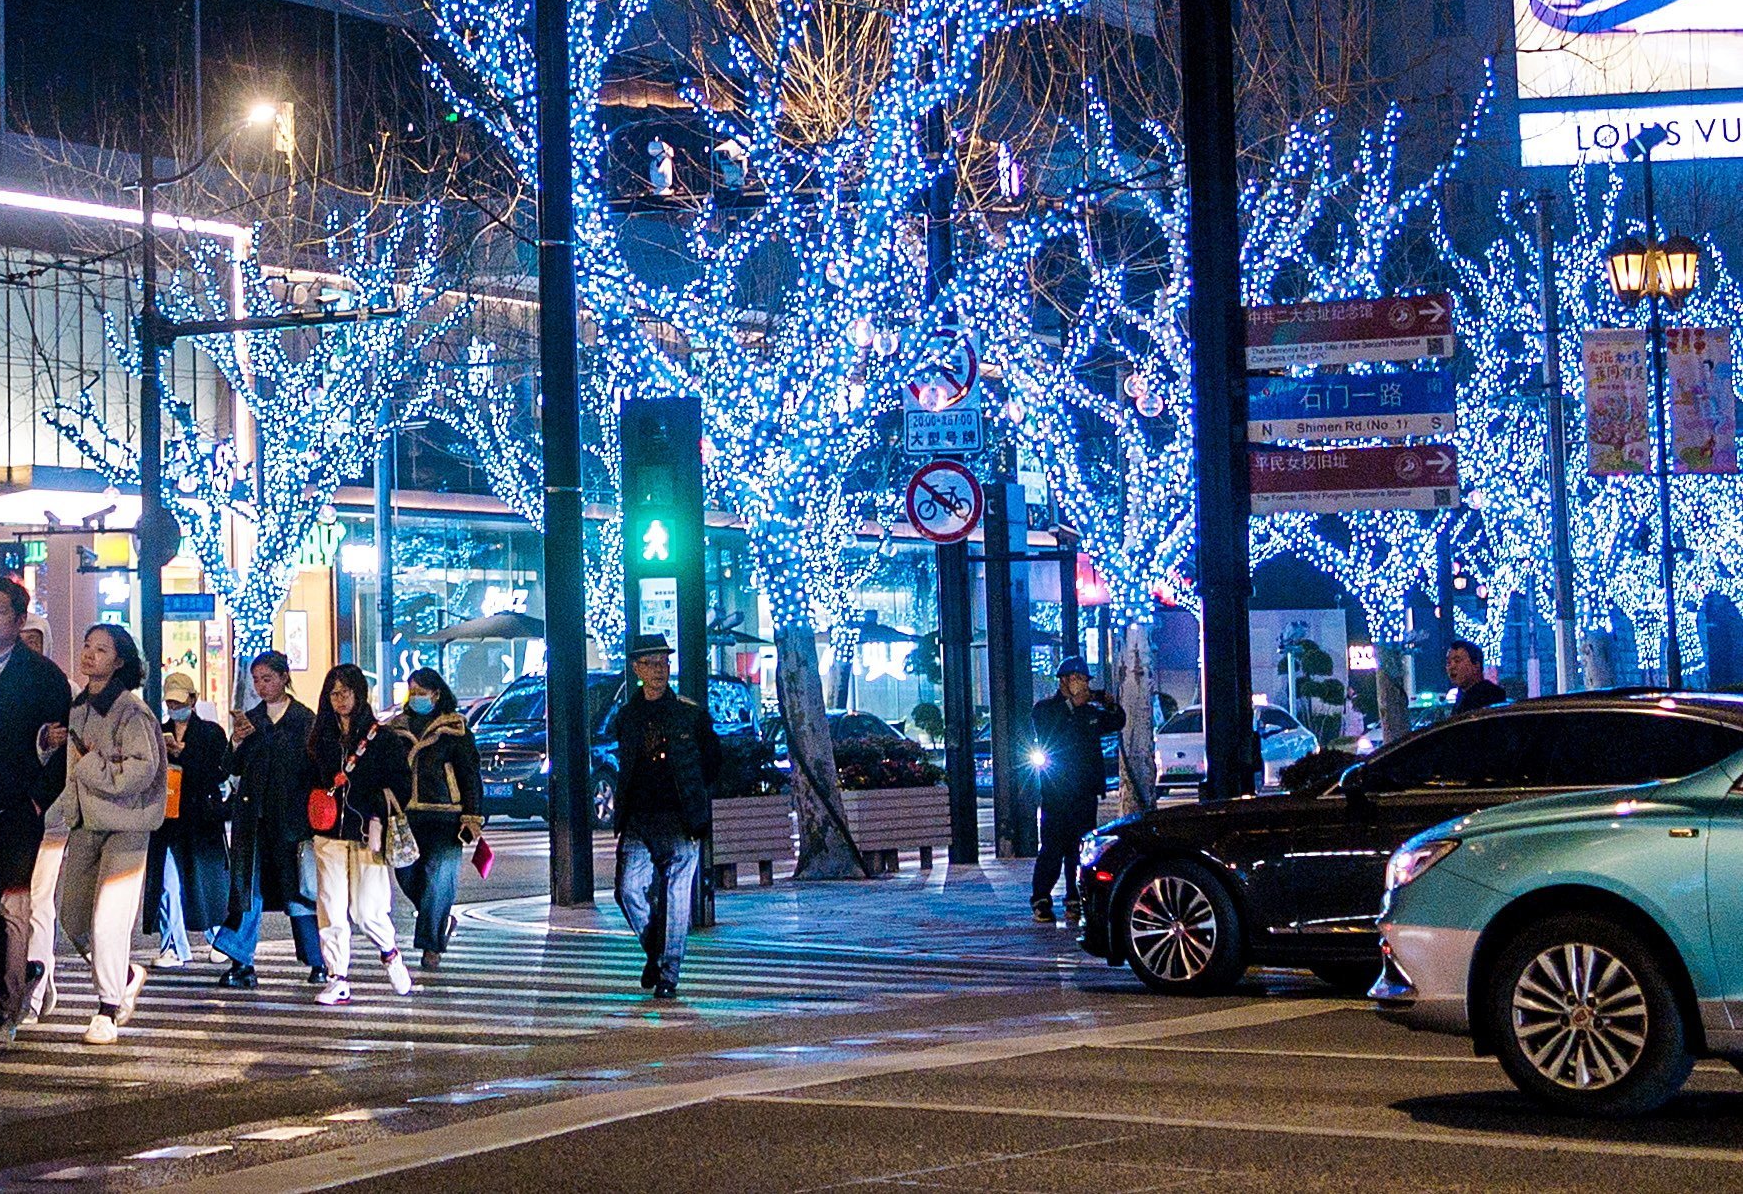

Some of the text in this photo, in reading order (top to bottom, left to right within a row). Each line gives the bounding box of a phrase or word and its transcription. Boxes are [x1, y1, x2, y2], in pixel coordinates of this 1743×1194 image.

[1298, 381, 1403, 410] 石门一路
[1261, 422, 1273, 437] N
[1296, 421, 1341, 434] Shimen
[1431, 416, 1442, 430] S
